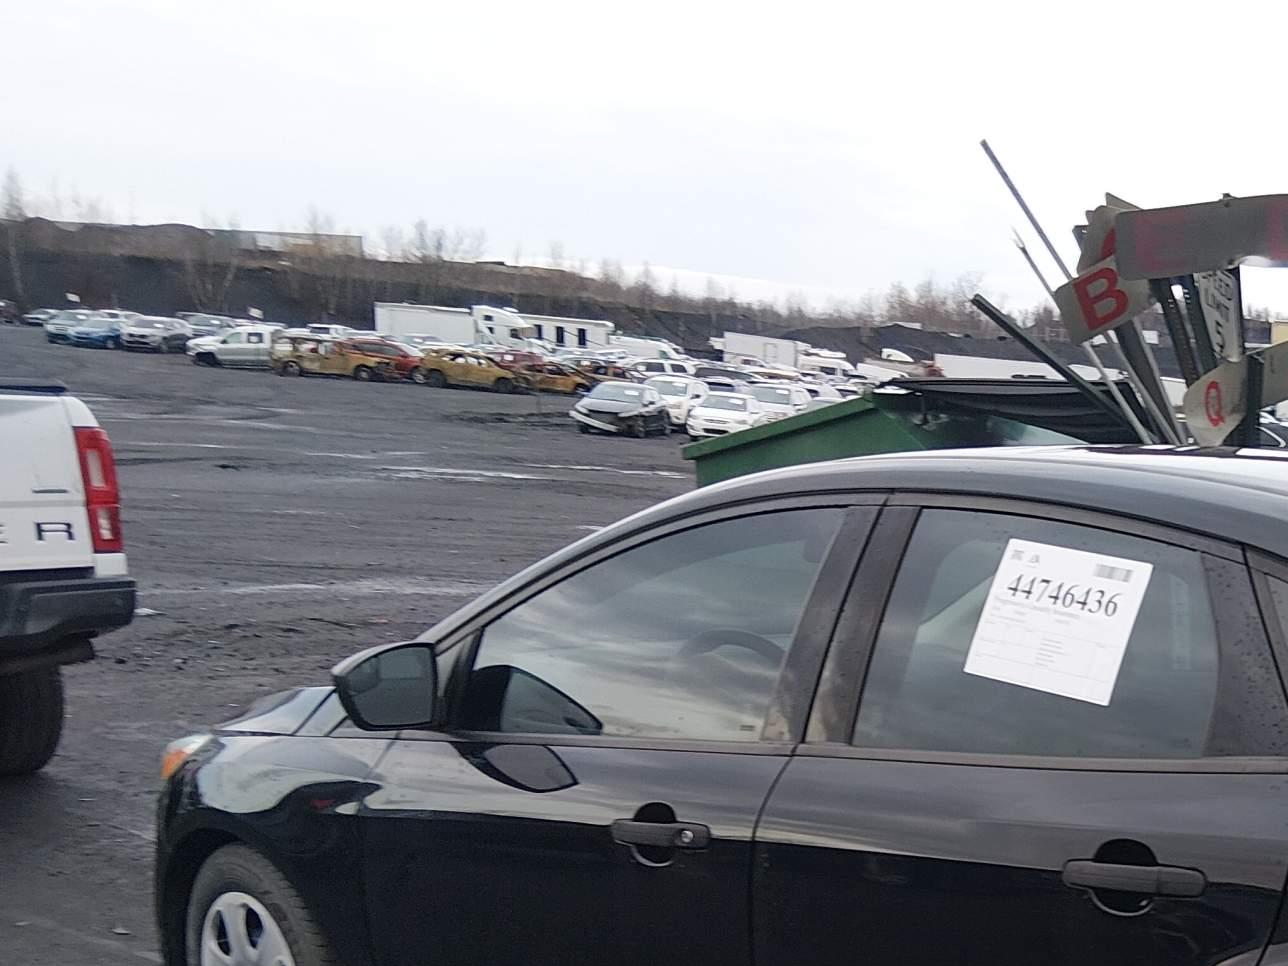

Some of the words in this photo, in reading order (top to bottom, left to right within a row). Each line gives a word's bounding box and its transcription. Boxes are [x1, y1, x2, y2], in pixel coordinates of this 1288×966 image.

[1072, 266, 1129, 332] B
[1204, 380, 1225, 427] Q
[0, 521, 76, 544] R
[1006, 574, 1124, 617] 44746436
